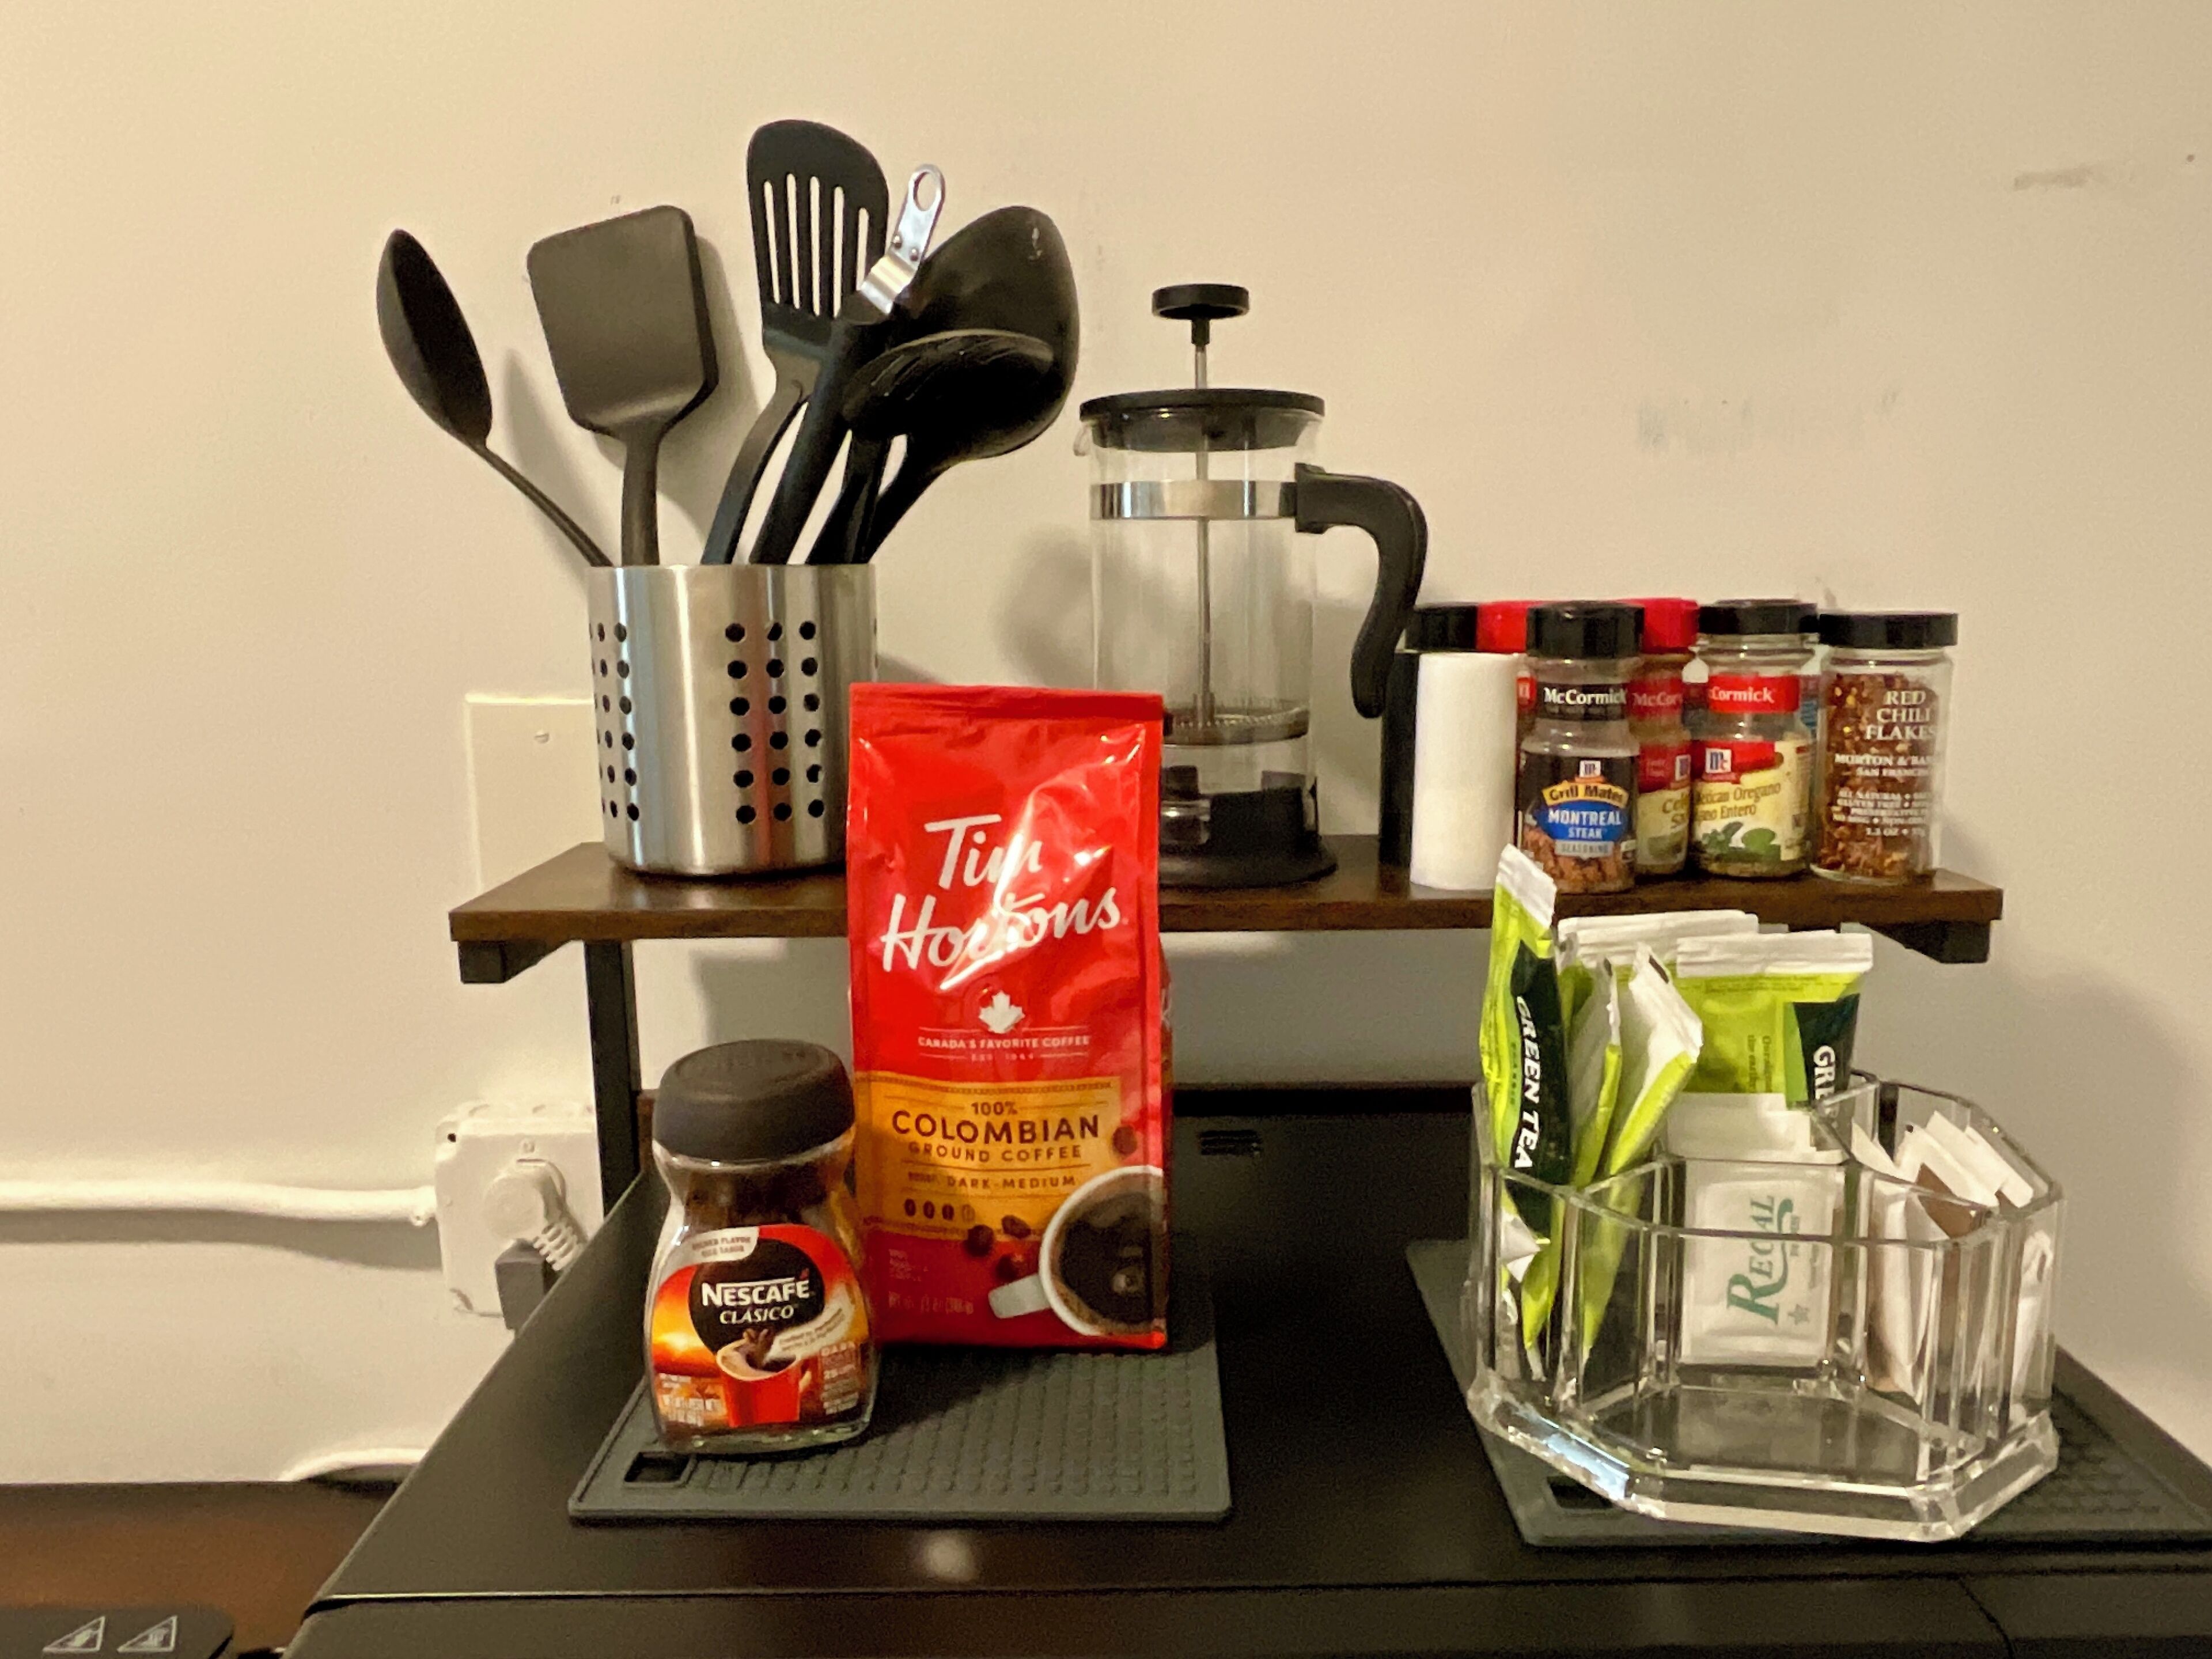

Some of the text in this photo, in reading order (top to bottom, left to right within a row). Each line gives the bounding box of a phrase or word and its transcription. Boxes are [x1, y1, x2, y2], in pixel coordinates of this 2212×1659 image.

[1544, 687, 1628, 705] McCormick
[1632, 691, 1682, 706] McCor
[1884, 691, 1926, 705] RED
[1877, 708, 1930, 722] CHILI
[1864, 725, 1937, 740] FLAKES
[1550, 785, 1579, 801] Grill
[1733, 782, 1782, 802] Oregano
[1548, 807, 1622, 825] MONTREAL
[1721, 804, 1756, 820] Entero
[1568, 827, 1603, 839] STEAK
[924, 813, 1043, 889] Tim
[880, 887, 1120, 972] Hortons
[980, 1037, 1039, 1049] FAVORITE
[1041, 1036, 1091, 1047] COFFEE
[1813, 1044, 1837, 1101] GRE
[1514, 996, 1541, 1168] GREEN TEA
[971, 1101, 1018, 1116] 100%
[892, 1110, 1099, 1145] COLOMBIAN
[908, 1141, 1082, 1163] GROUND COFFEE
